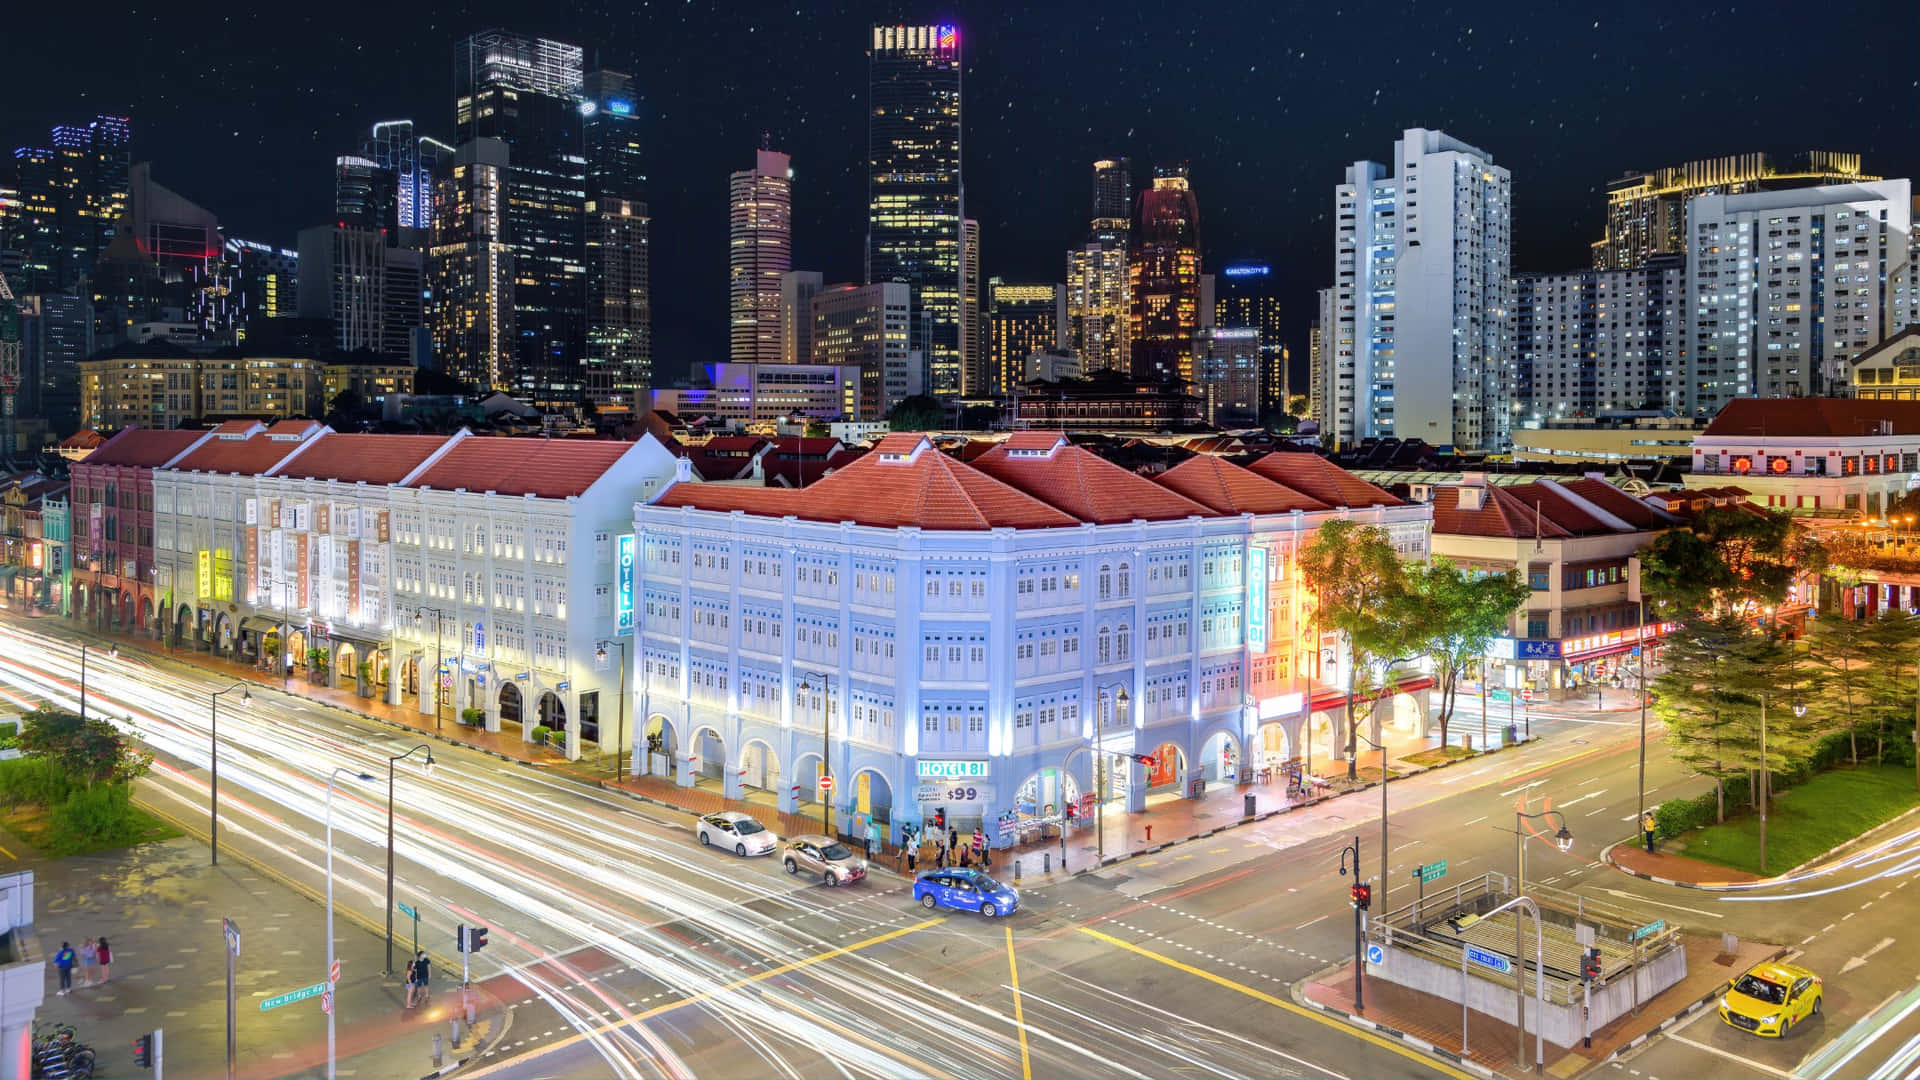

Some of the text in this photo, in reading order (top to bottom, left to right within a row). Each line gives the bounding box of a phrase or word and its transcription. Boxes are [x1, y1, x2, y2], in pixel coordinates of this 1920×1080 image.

[619, 541, 633, 626] HOTEL 81
[1250, 552, 1263, 643] HOTEL 81
[920, 762, 984, 775] HOTEL 81
[947, 787, 977, 800] $99
[264, 1000, 281, 1008] New
